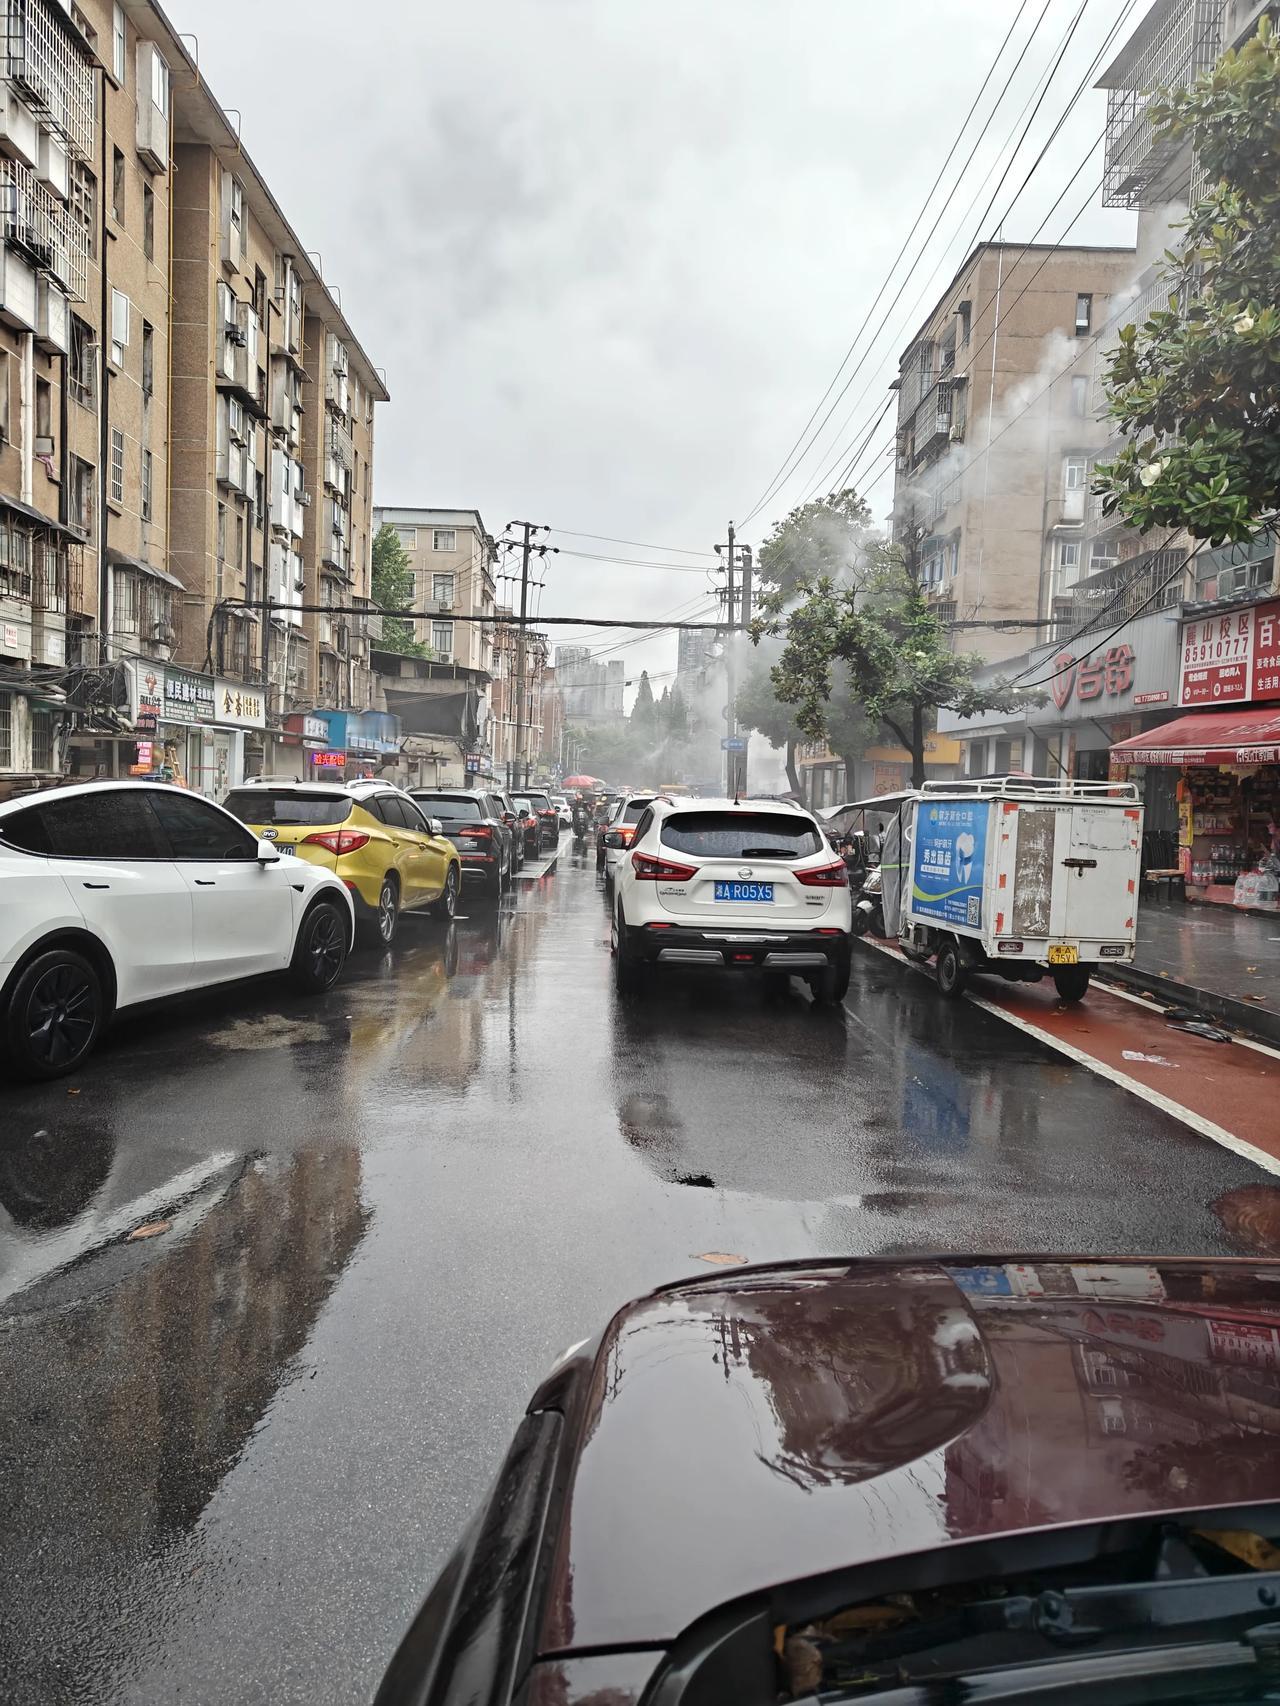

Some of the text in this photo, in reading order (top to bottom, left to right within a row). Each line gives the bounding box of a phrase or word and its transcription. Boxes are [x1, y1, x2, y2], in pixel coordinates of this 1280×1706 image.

[1186, 613, 1249, 646] 麓山校区
[1259, 614, 1280, 648] 百
[1185, 637, 1248, 663] 85910777
[1077, 644, 1134, 700] 台铃
[1257, 676, 1280, 690] 生活用
